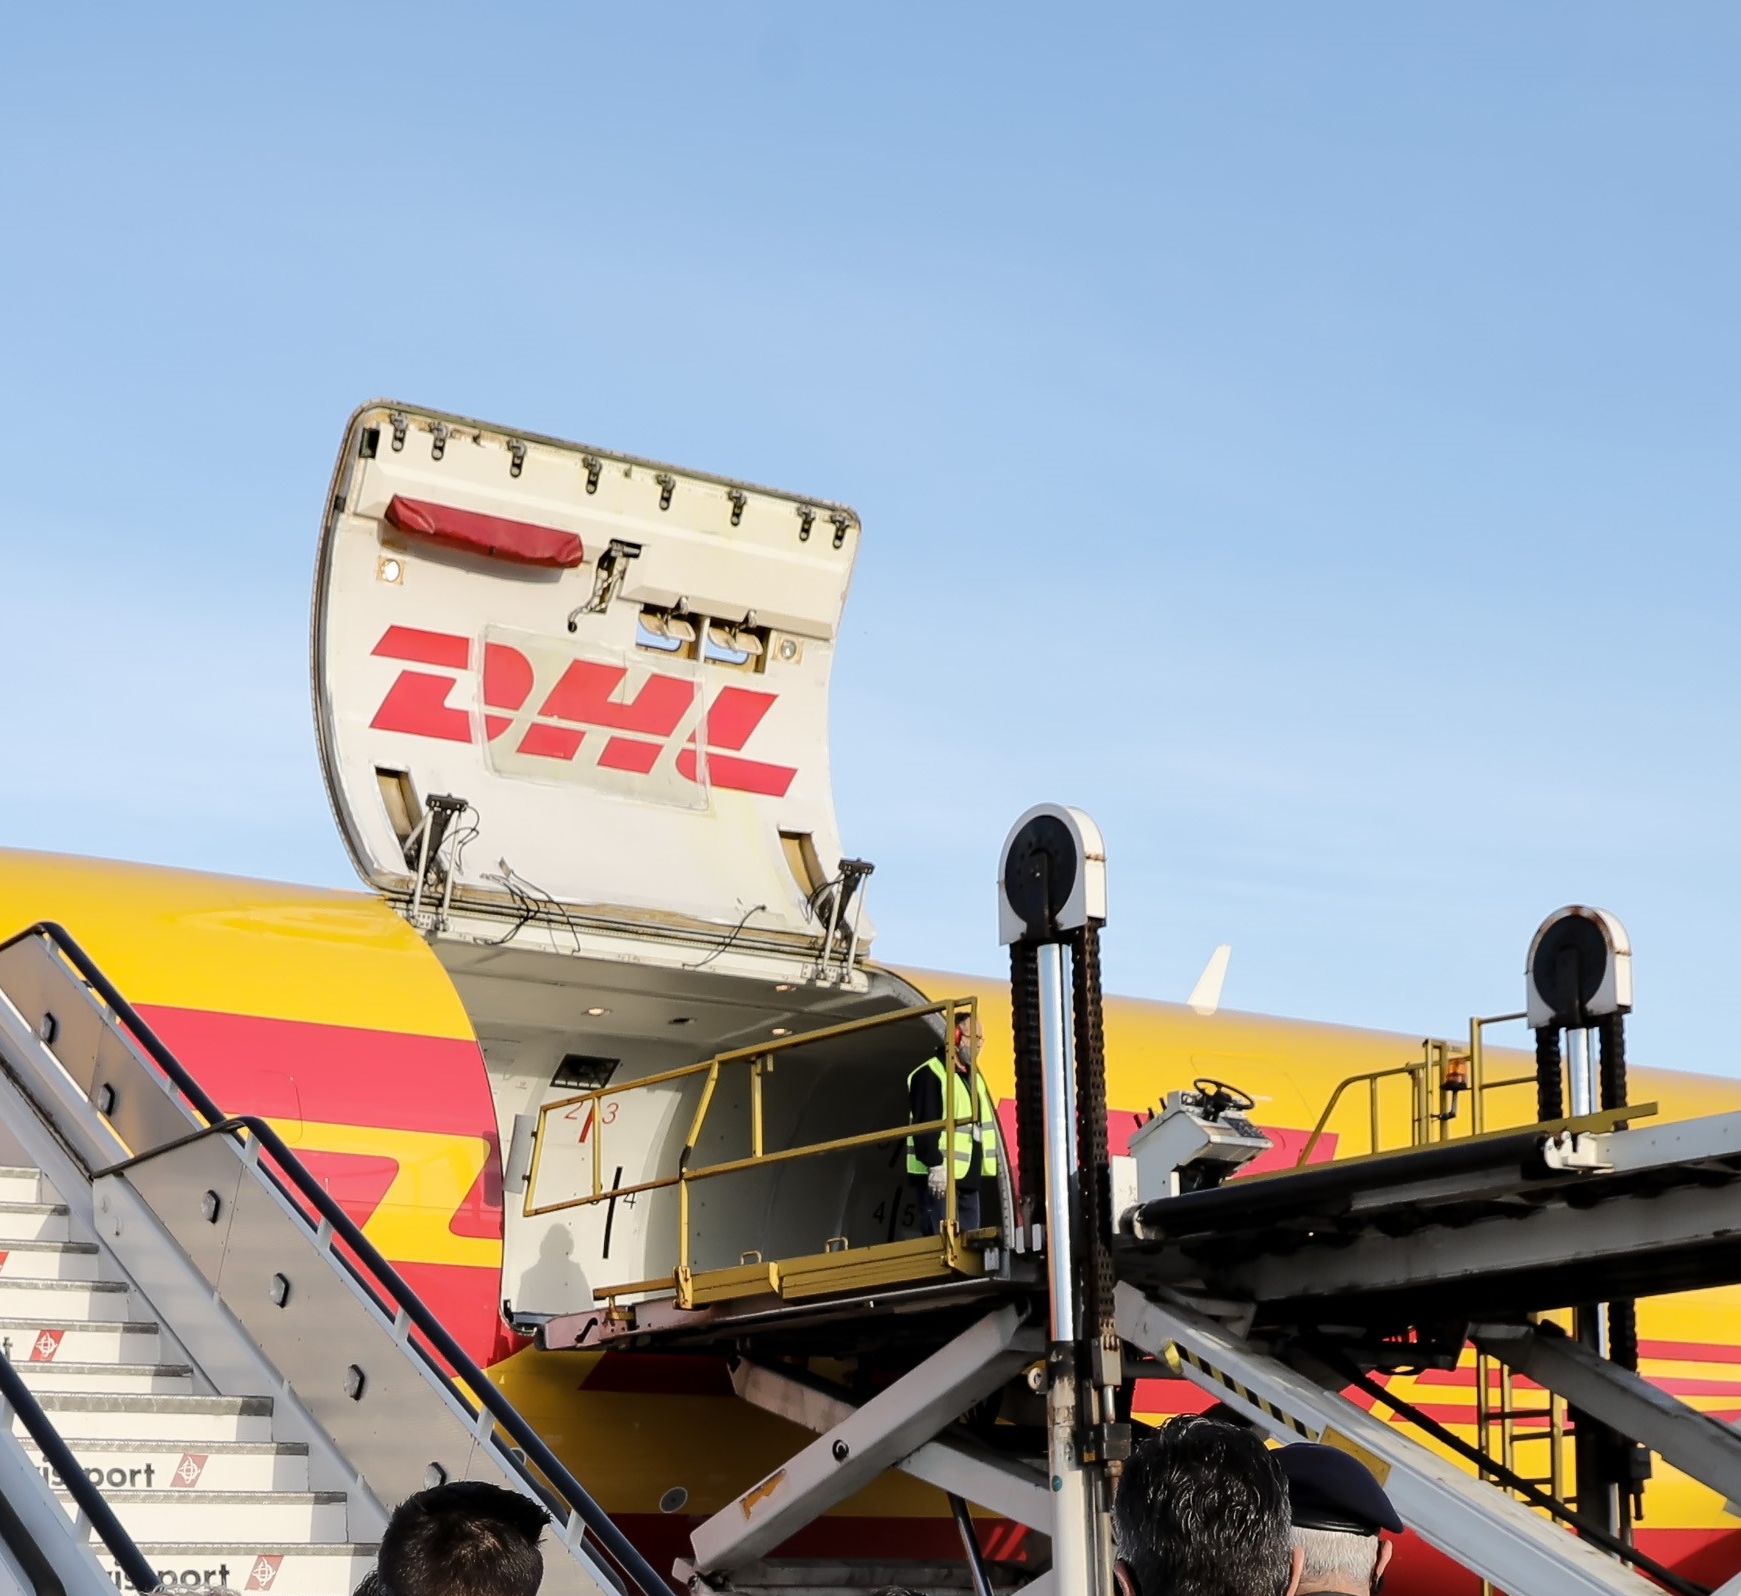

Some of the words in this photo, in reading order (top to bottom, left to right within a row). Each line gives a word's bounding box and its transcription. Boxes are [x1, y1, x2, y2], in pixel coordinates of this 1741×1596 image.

[369, 625, 799, 798] DHL
[602, 1102, 619, 1124] 3
[36, 1456, 155, 1488] isport
